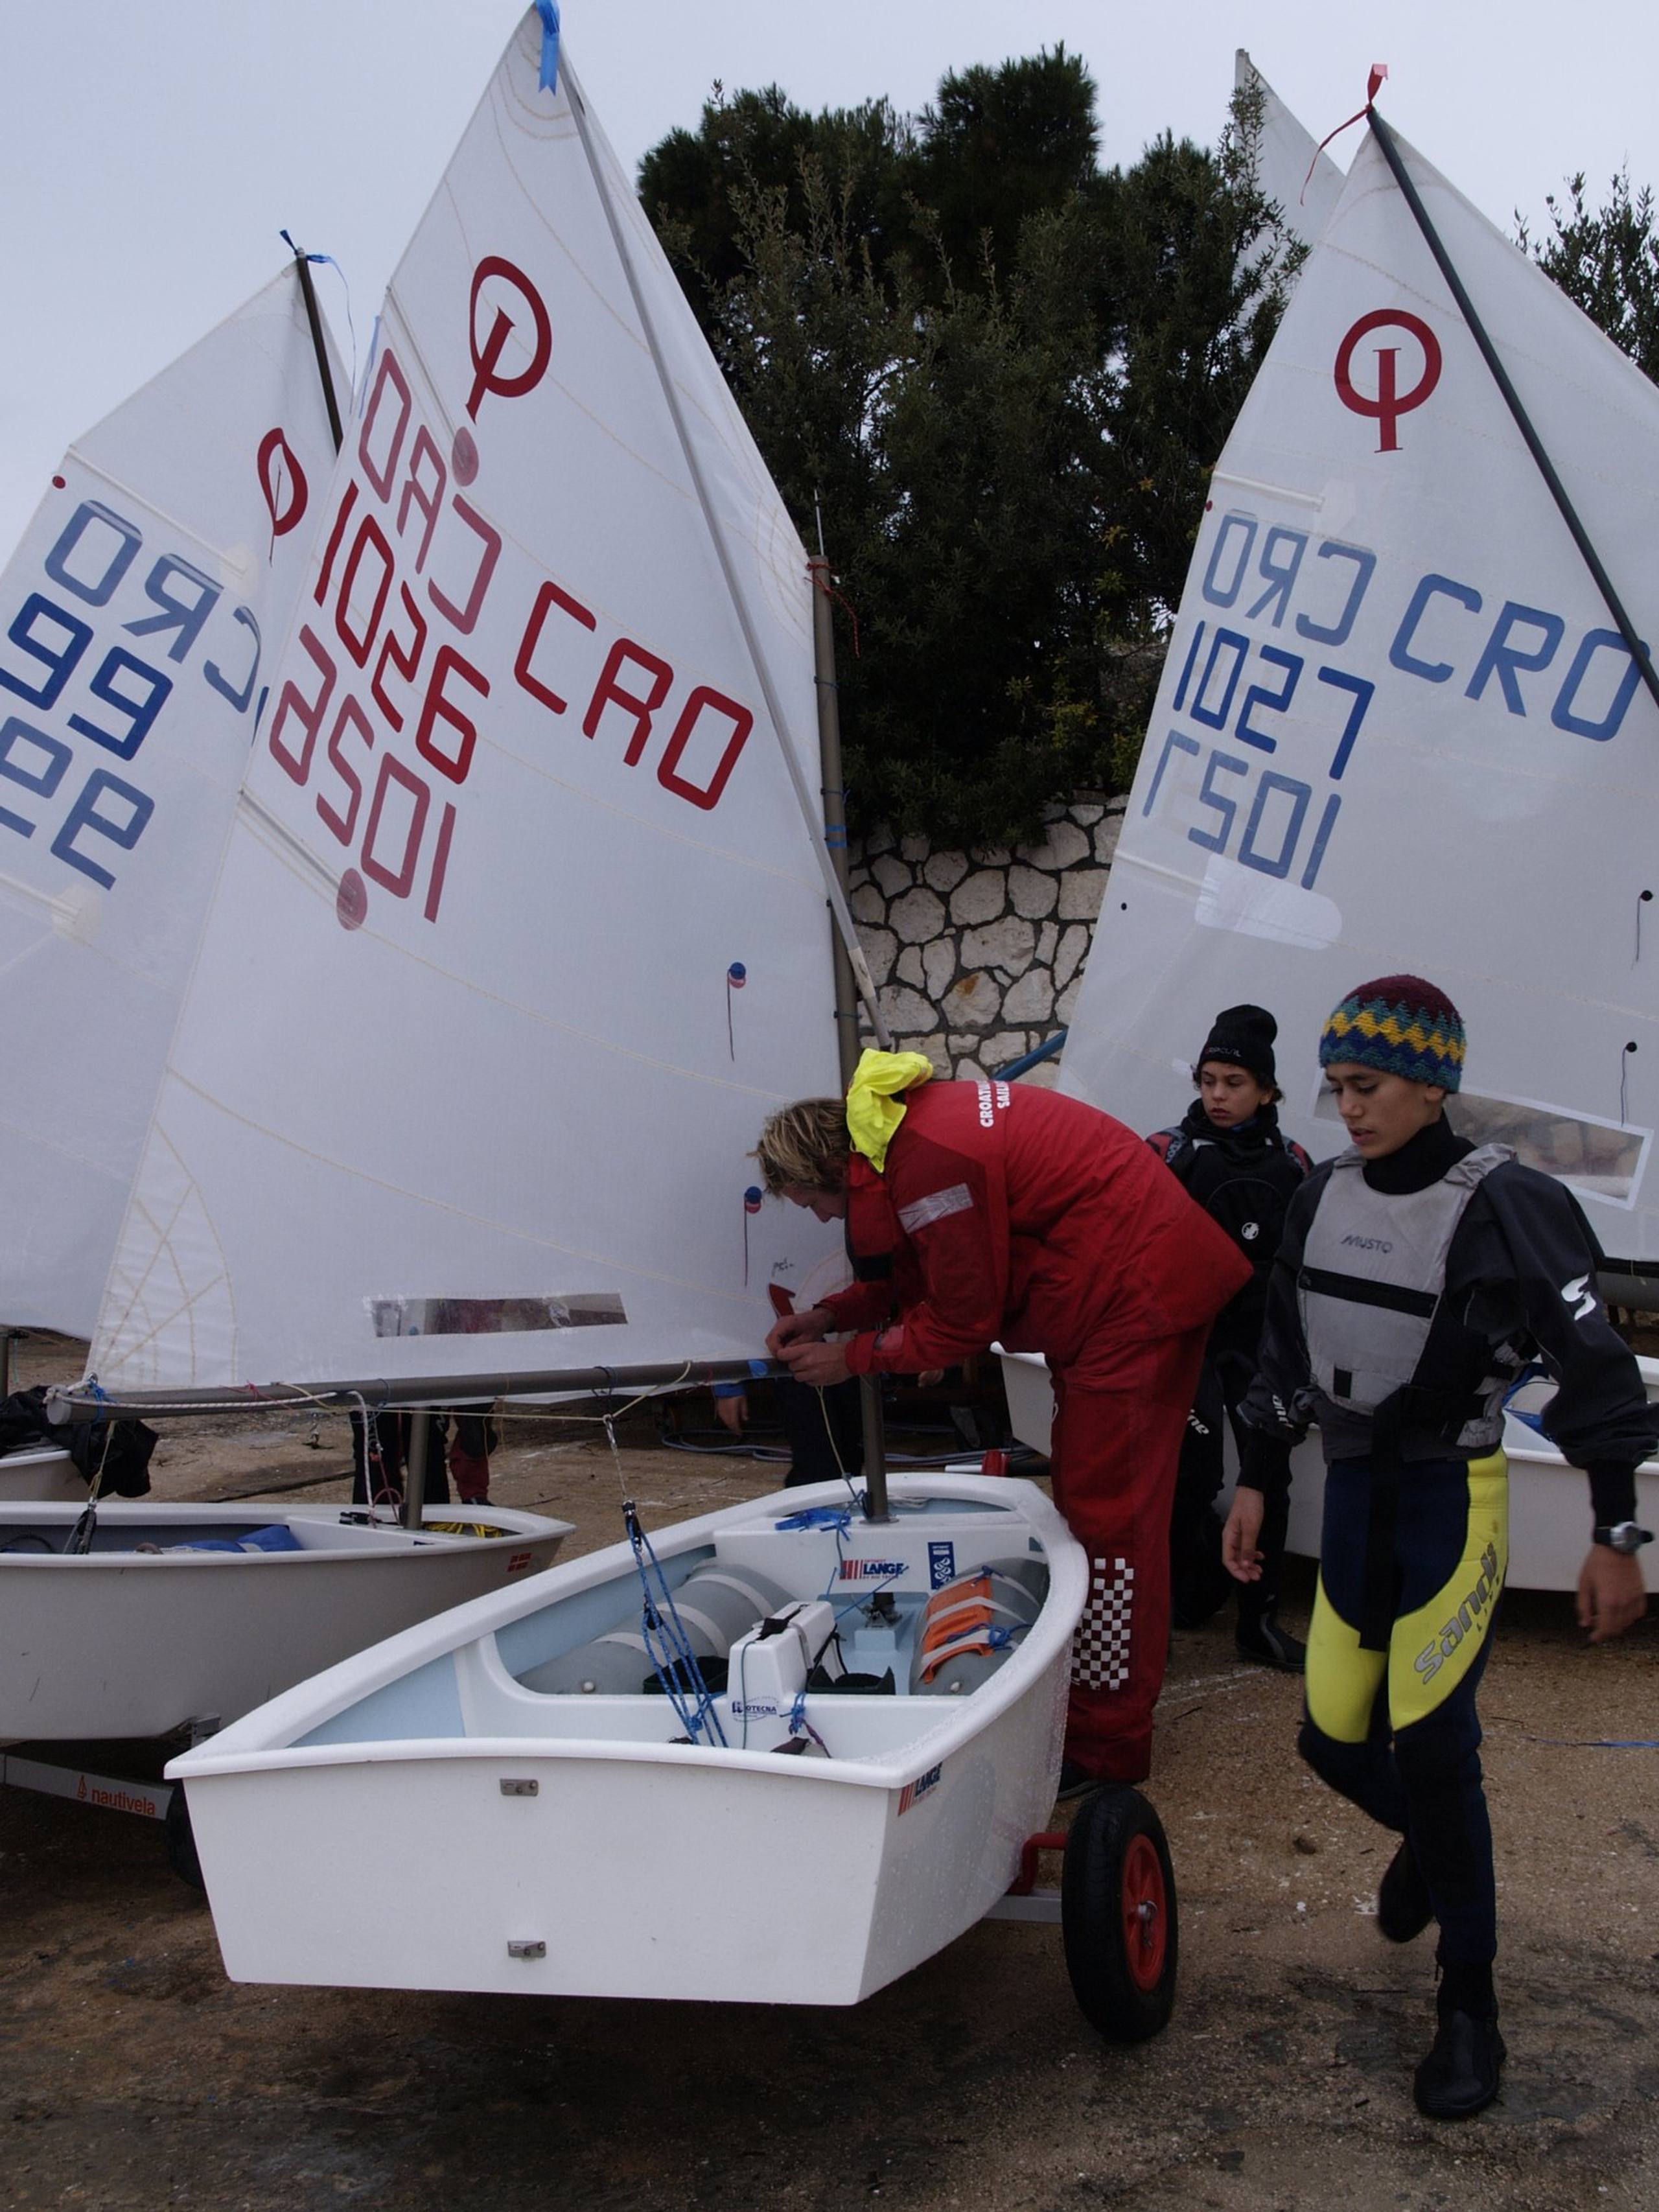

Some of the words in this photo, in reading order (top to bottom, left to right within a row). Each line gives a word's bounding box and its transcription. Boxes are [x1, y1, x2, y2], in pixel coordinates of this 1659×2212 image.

[314, 479, 490, 784] 1026
[514, 580, 754, 811] CRO
[1172, 621, 1375, 780] 1027
[1389, 574, 1651, 741] CRO
[1340, 1235, 1393, 1254] MUSTO
[863, 1563, 904, 1574] LANGE
[91, 1788, 156, 1815] nautivela
